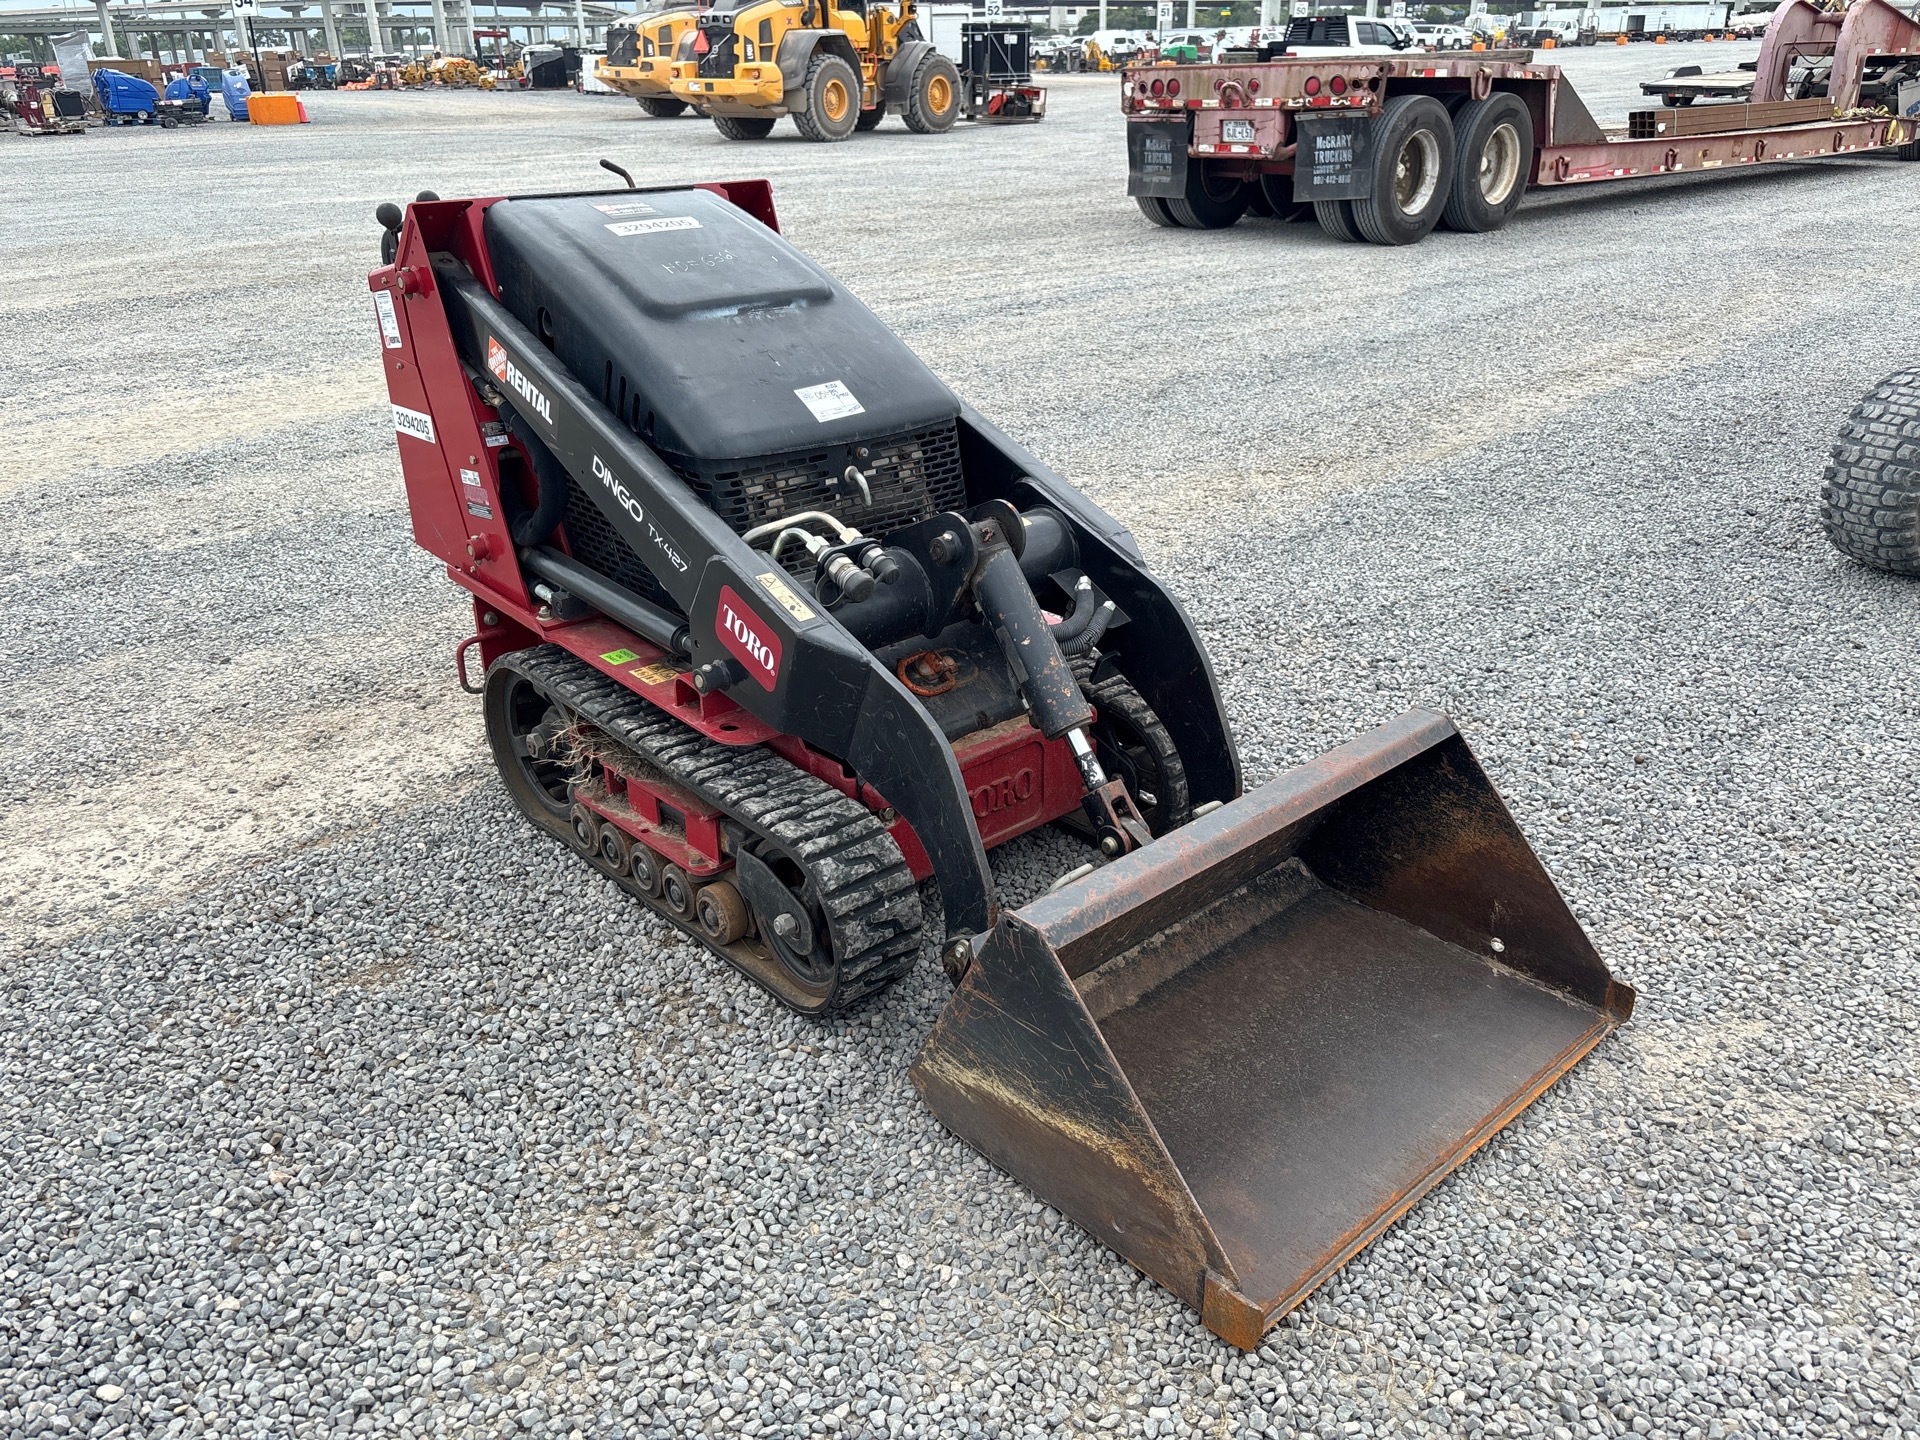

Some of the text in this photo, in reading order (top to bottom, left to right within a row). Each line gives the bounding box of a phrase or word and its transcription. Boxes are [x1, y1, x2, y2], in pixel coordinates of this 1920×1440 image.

[987, 5, 1000, 16] 52
[1160, 8, 1170, 17] 51
[1296, 6, 1306, 15] 50
[1316, 134, 1352, 149] McCRARY
[1313, 149, 1353, 164] TRUCKING
[618, 219, 692, 233] 3294205
[488, 350, 506, 369] HOME
[507, 360, 553, 426] RENTAL
[396, 411, 430, 435] 3294205
[592, 455, 643, 522] DINGO
[723, 604, 775, 670] TORO
[969, 767, 1036, 817] ORO
